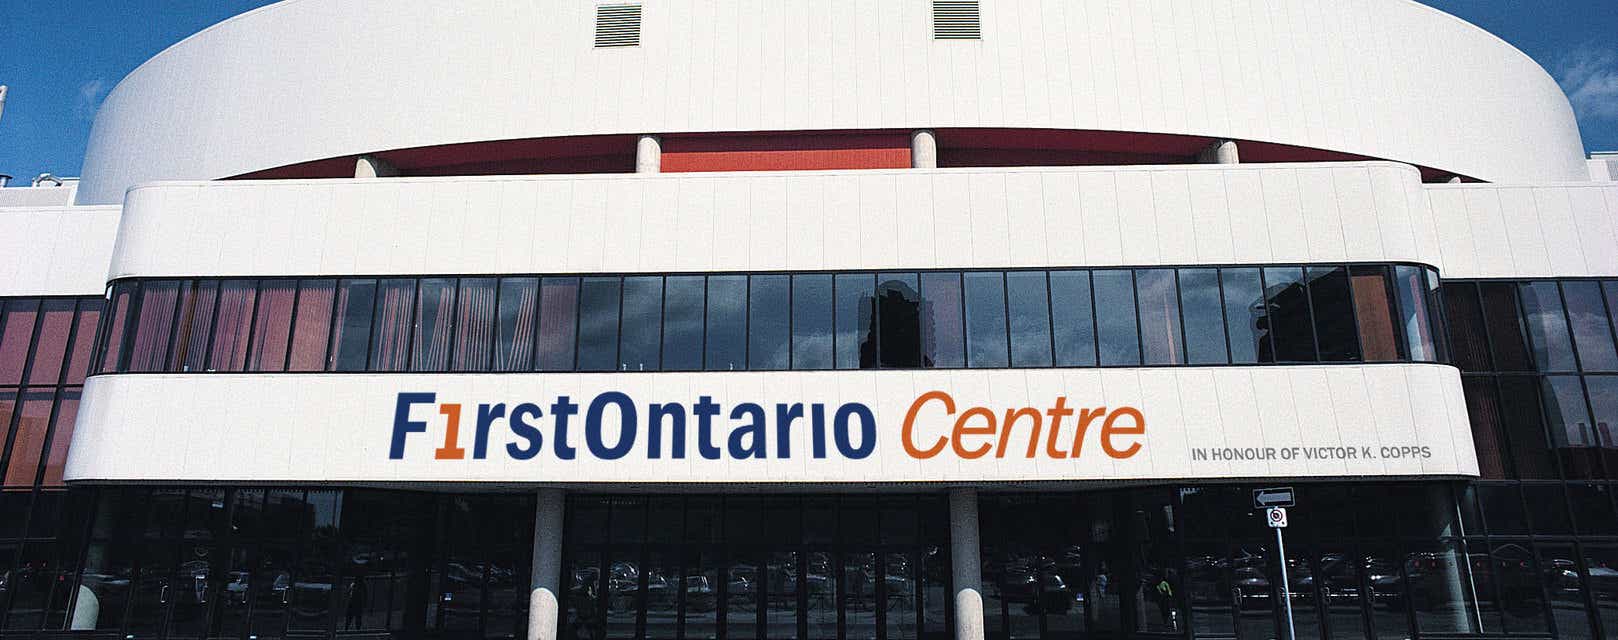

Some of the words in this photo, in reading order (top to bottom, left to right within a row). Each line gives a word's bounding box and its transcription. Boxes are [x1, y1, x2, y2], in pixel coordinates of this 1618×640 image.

[901, 390, 1146, 460] Centre
[1192, 447, 1208, 461] IN
[1211, 447, 1277, 461] HONOUR
[1280, 447, 1300, 460] OF
[1303, 446, 1358, 460] VICTOR
[1361, 446, 1377, 460] K.
[1380, 446, 1432, 459] COPPS
